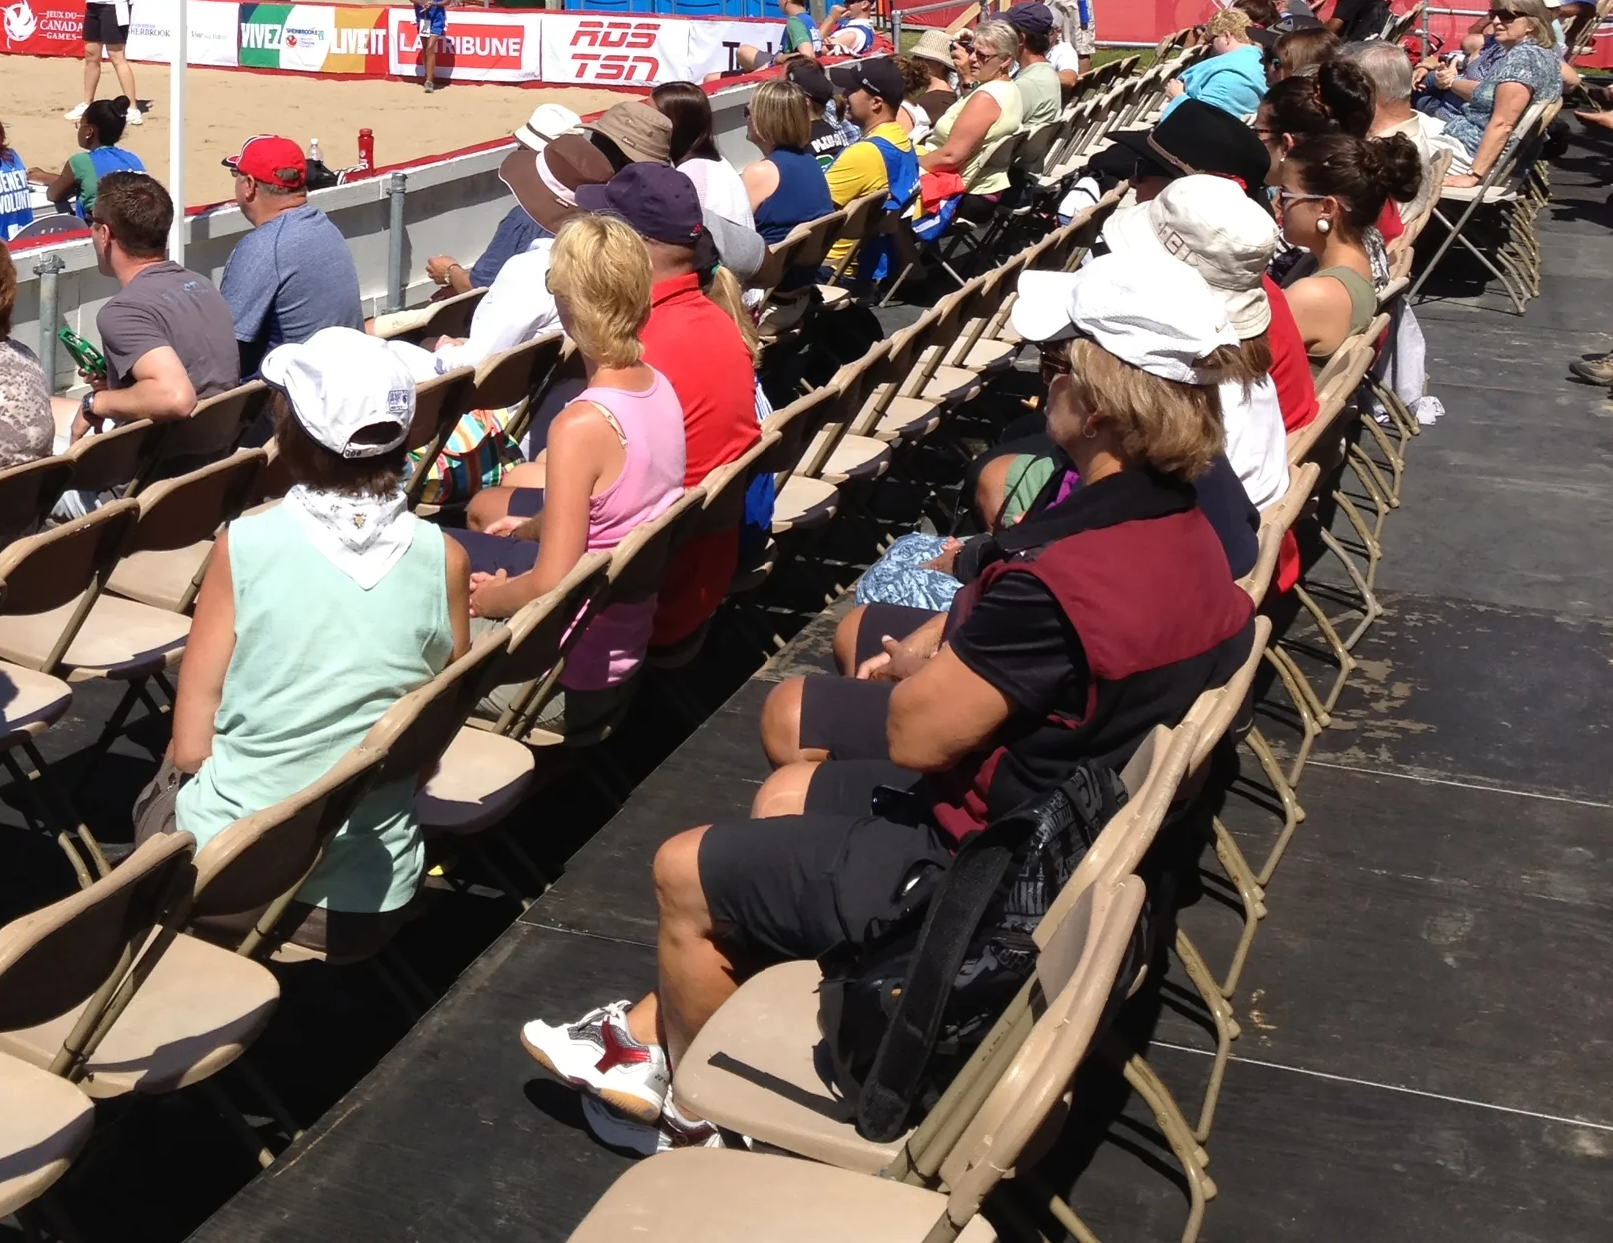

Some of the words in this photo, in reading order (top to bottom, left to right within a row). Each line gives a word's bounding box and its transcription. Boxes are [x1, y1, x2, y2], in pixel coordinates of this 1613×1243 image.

[46, 10, 64, 19] JEUX
[65, 11, 78, 19] DU
[39, 19, 83, 32] CANADA
[285, 27, 318, 36] SHERBROOKE
[569, 20, 661, 49] RDS
[46, 32, 77, 41] GAMES
[241, 22, 283, 50] VIVEZ
[330, 27, 369, 55] LIVE
[369, 28, 387, 55] IT
[399, 32, 423, 52] LA
[571, 53, 660, 82] TSN
